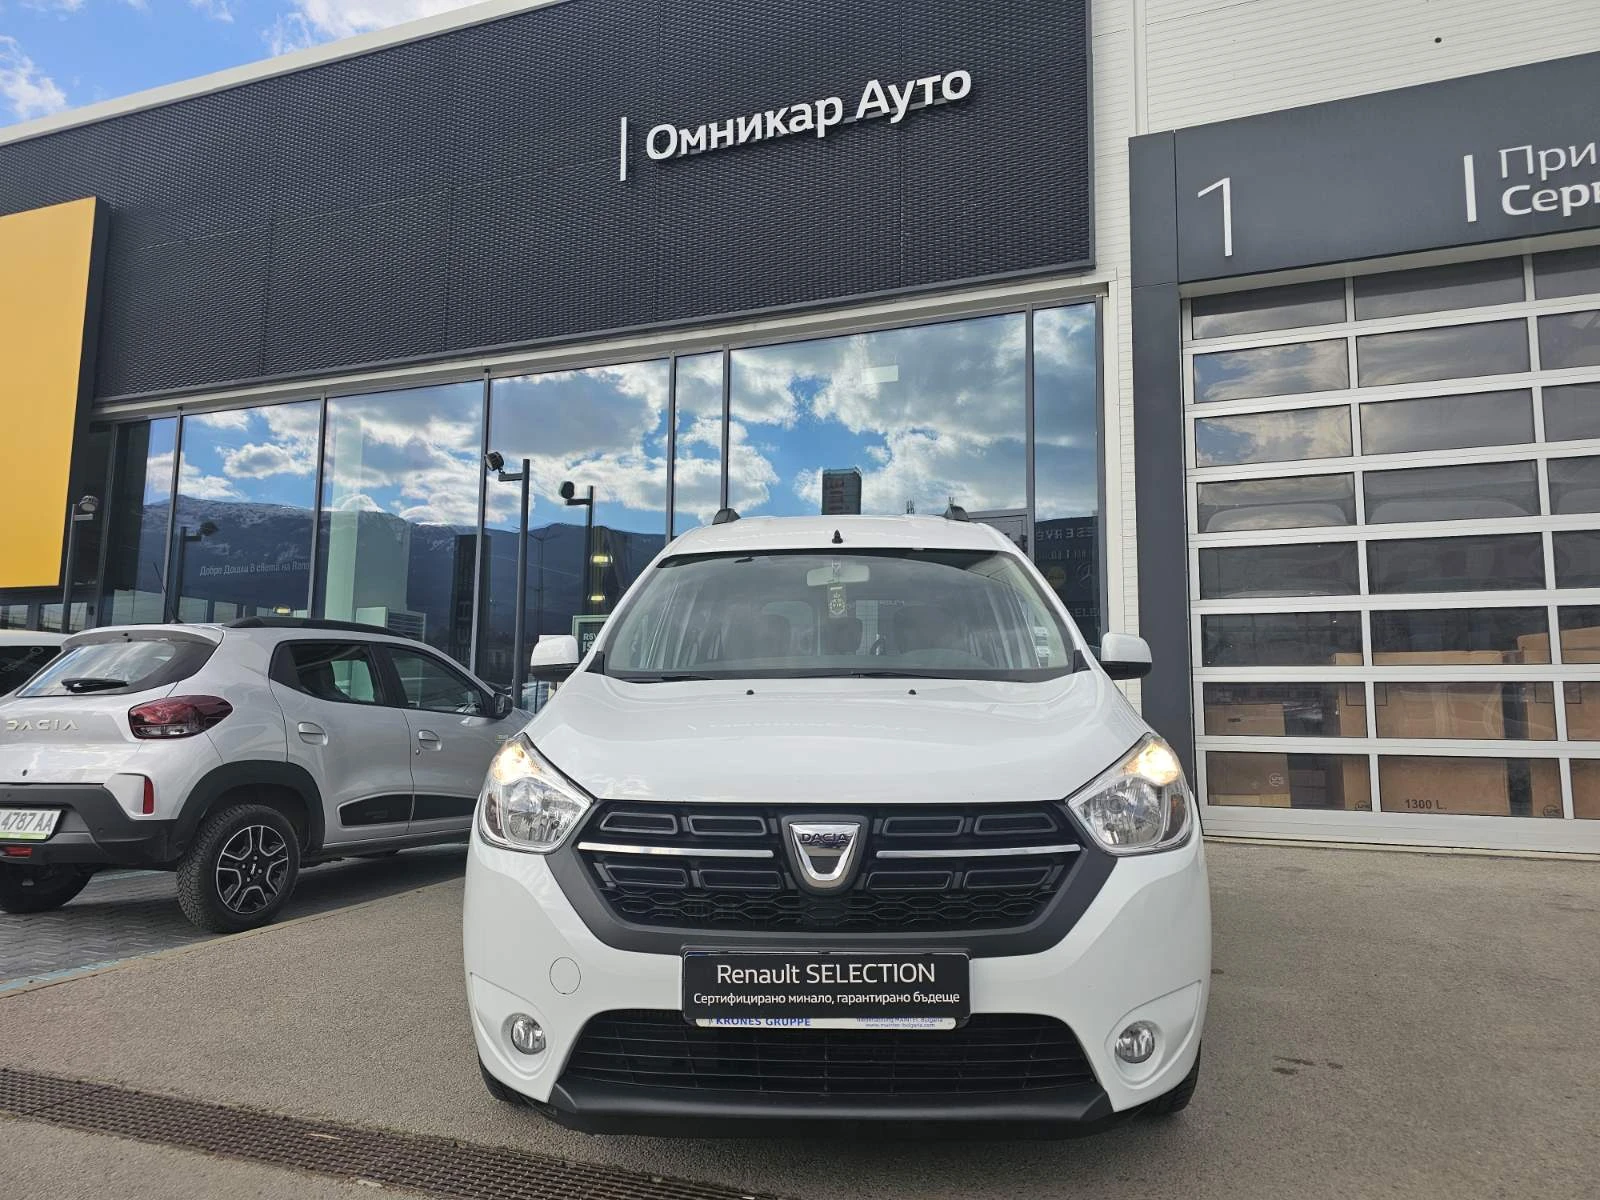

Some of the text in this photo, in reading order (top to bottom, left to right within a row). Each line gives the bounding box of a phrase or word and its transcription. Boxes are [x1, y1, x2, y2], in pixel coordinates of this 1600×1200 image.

[646, 70, 972, 160] Омникар Ауто
[1197, 177, 1233, 257] 1
[6, 719, 79, 731] DACIA
[1405, 799, 1433, 809] 1300
[1, 811, 36, 831] 4787
[801, 833, 848, 843] DACIA
[717, 963, 935, 984] Renault SELECTION
[693, 991, 960, 1006] Сертифицирано минало, гарантирано бъдеще
[715, 1017, 812, 1027] KRONES GRUPPE
